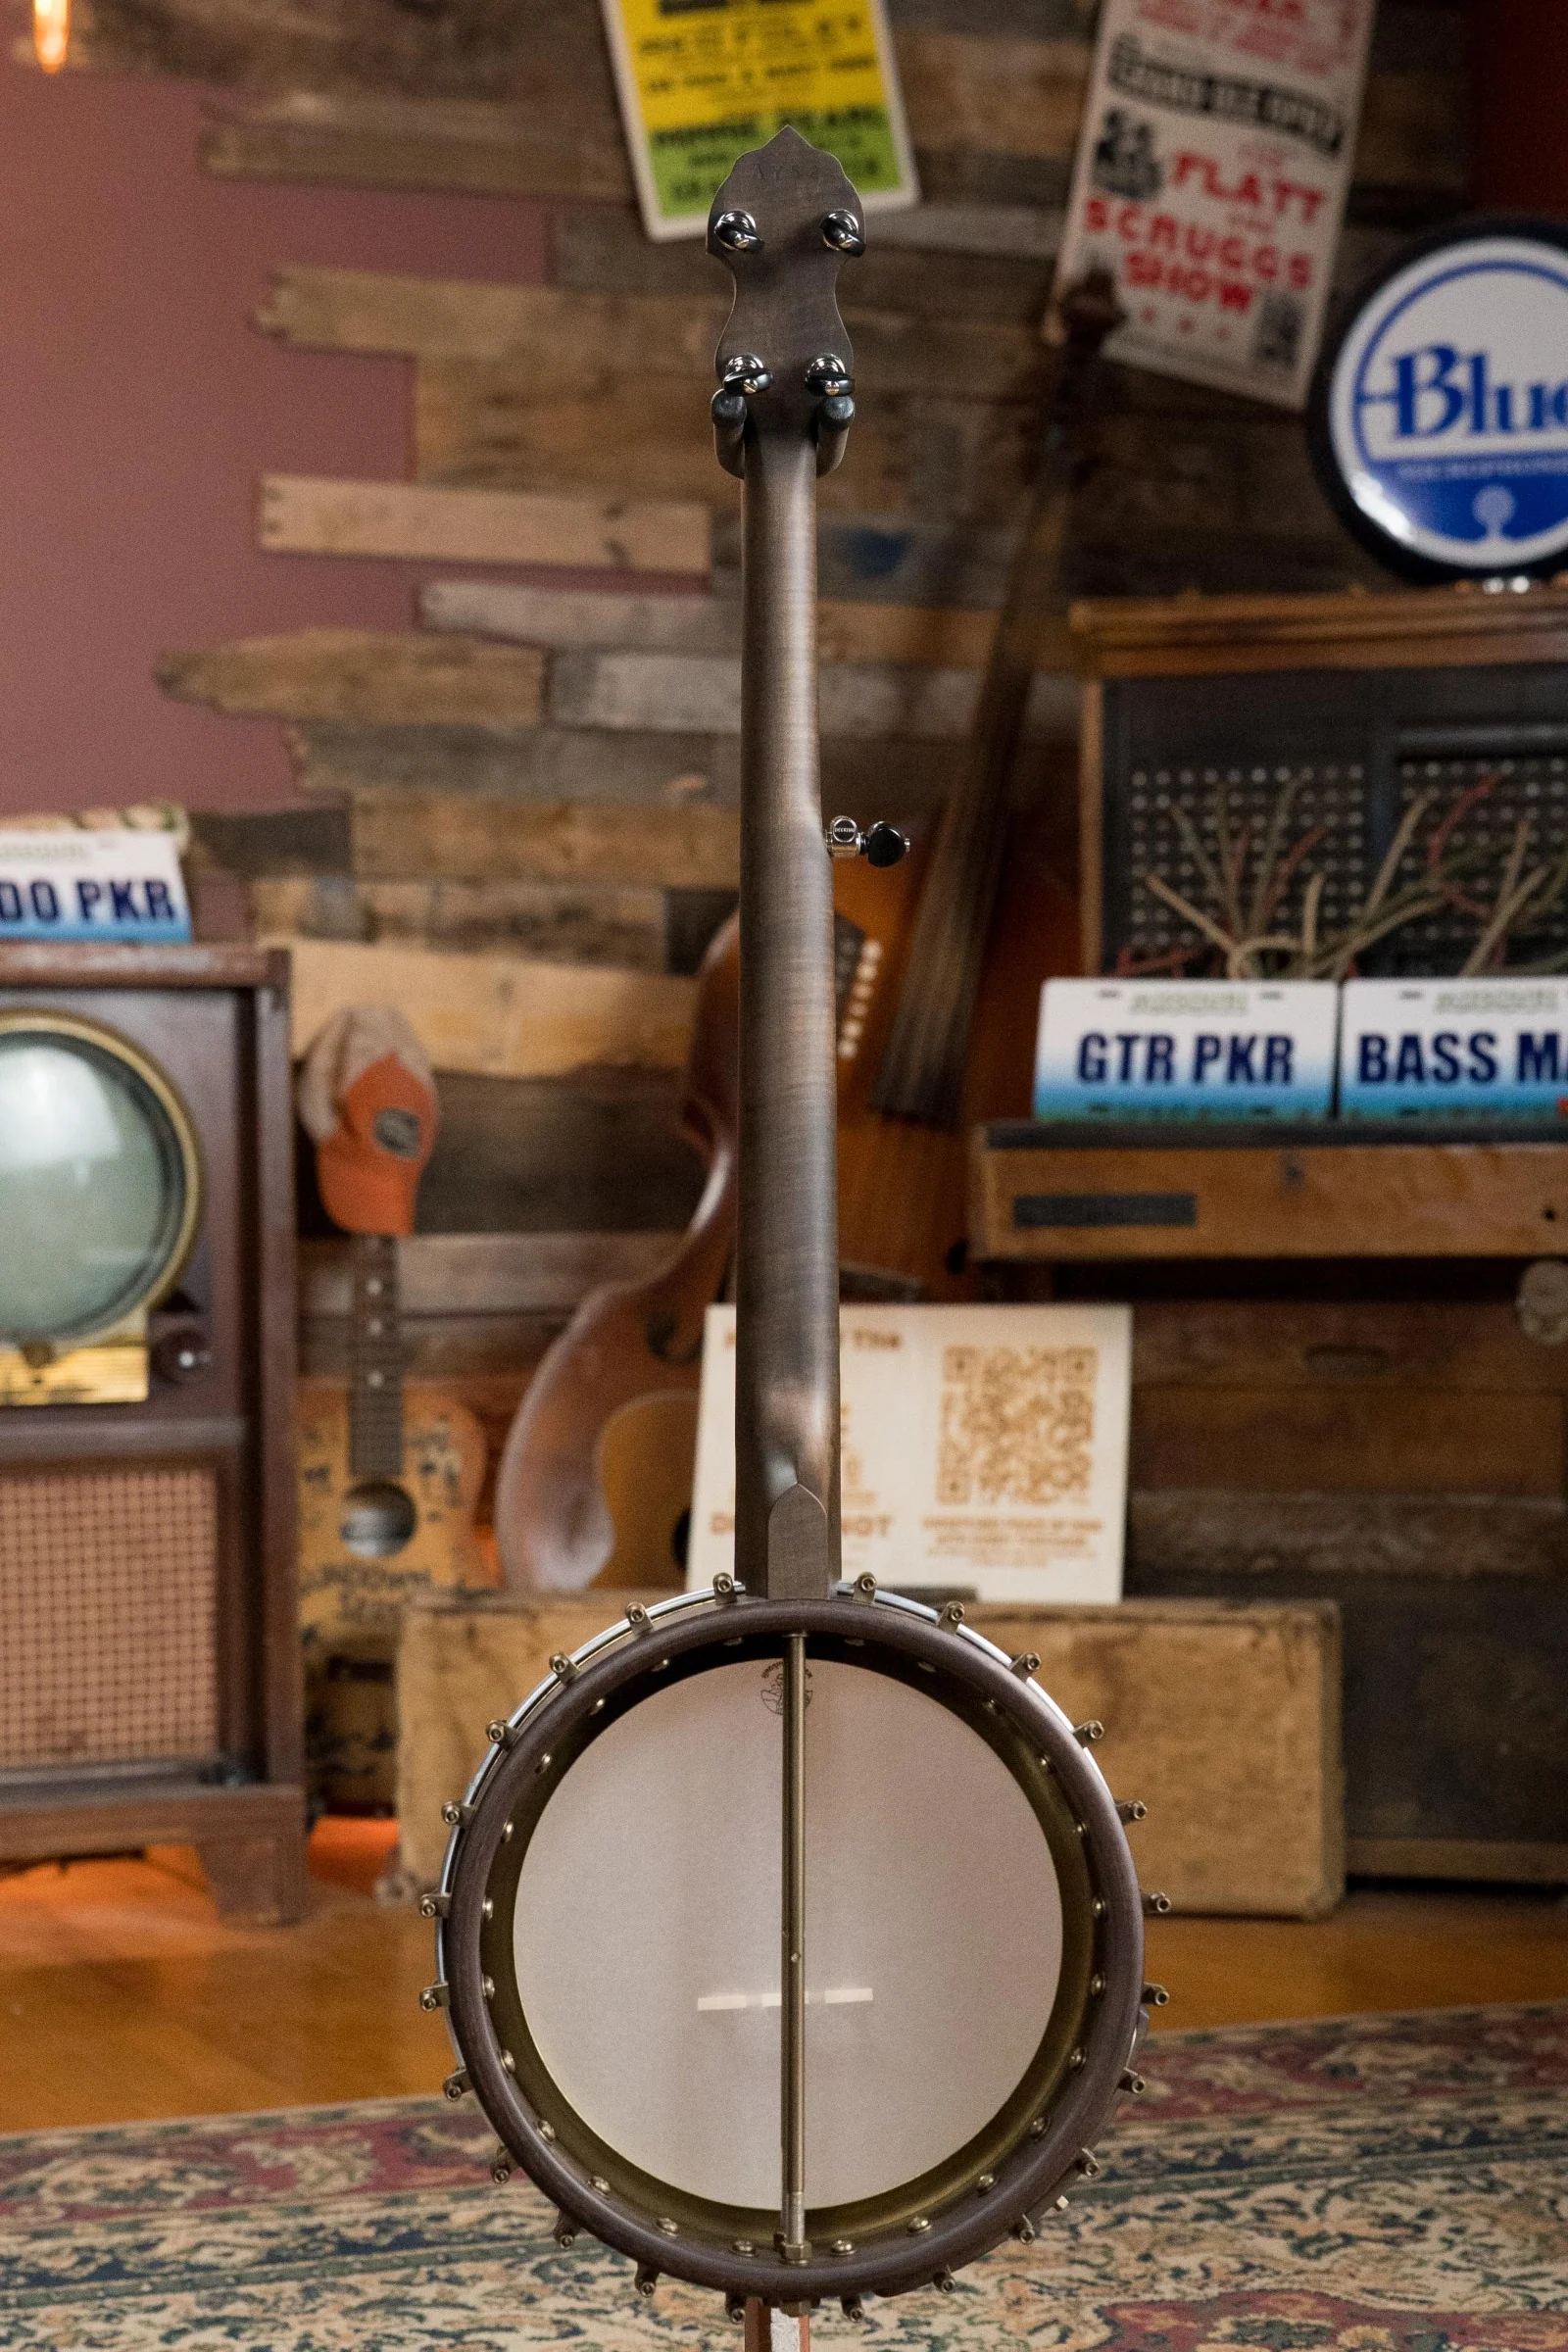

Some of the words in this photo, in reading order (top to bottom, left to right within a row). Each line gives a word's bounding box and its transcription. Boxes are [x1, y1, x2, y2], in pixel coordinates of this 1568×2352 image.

[1173, 149, 1329, 226] FLATT
[1084, 194, 1314, 291] SCRUGGS
[1125, 251, 1254, 315] SHOW
[74, 879, 175, 922] PKR
[1077, 1031, 1176, 1087] GTR
[1192, 1032, 1295, 1088] PKR
[1358, 1031, 1499, 1086] BASS
